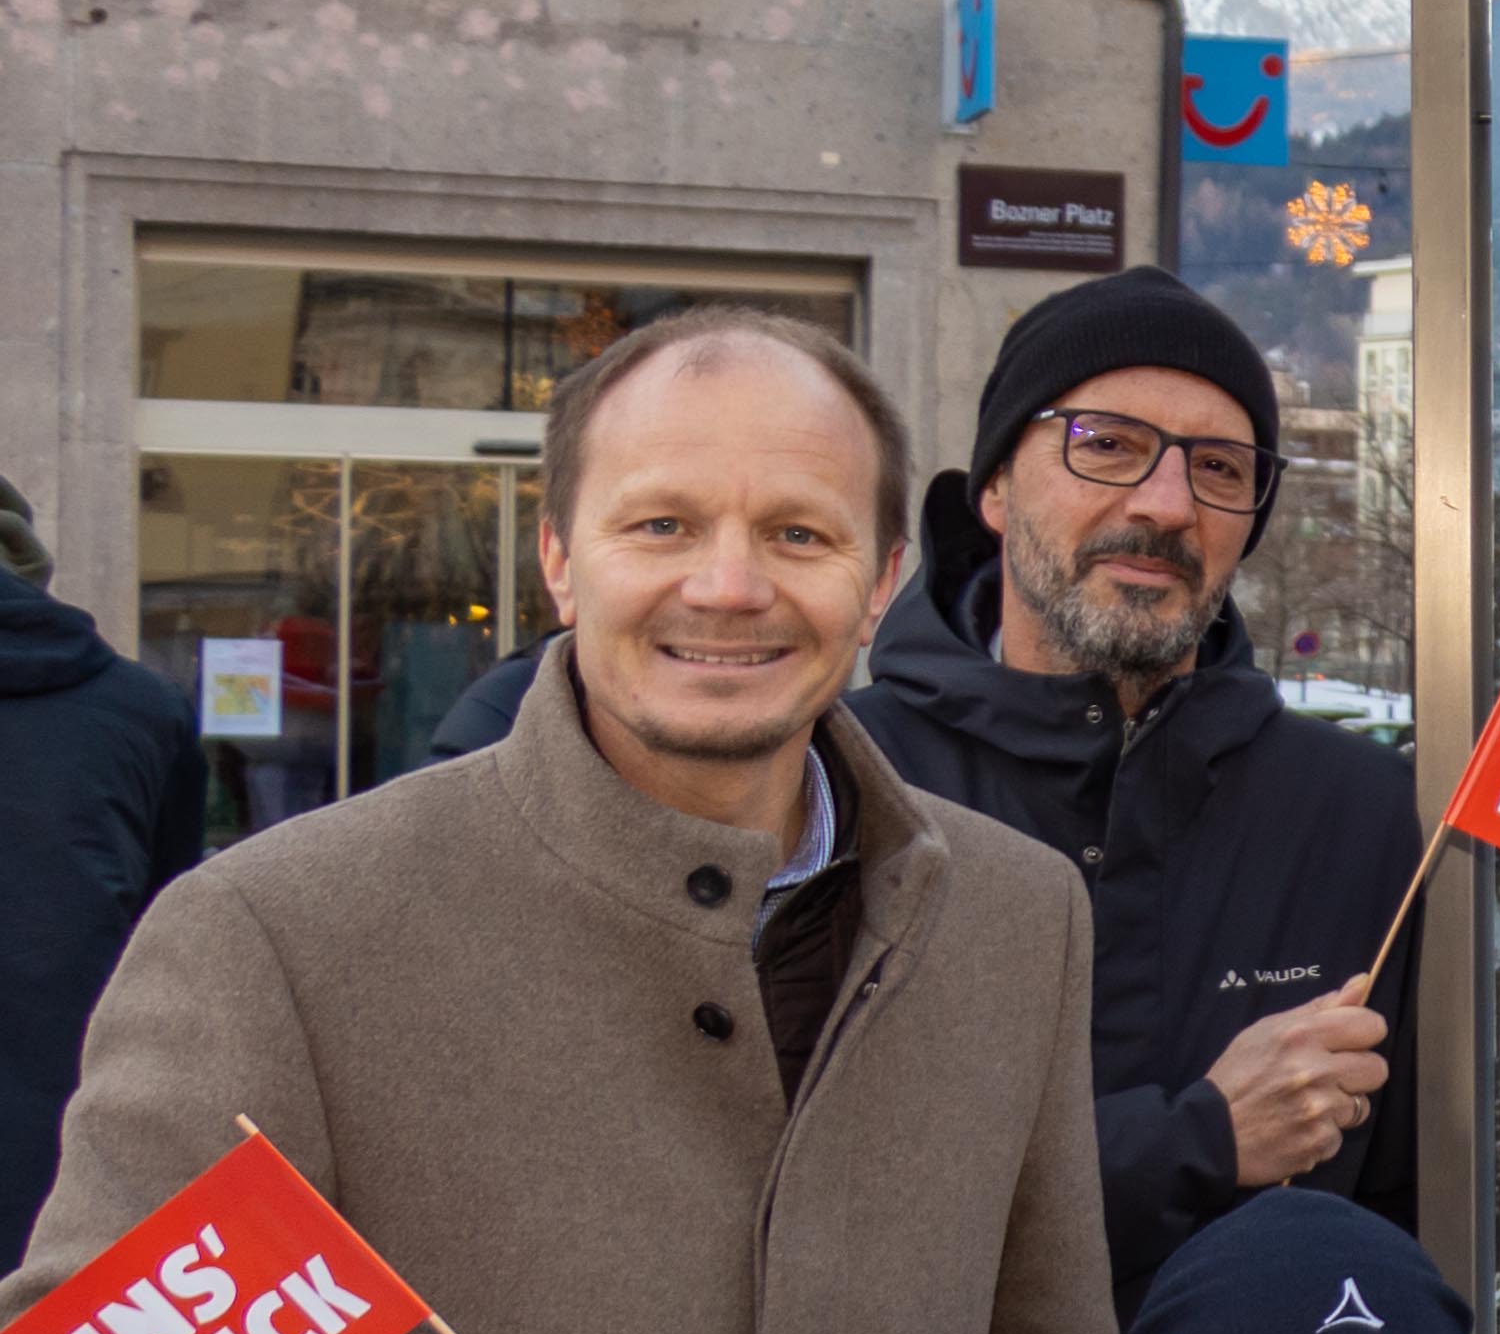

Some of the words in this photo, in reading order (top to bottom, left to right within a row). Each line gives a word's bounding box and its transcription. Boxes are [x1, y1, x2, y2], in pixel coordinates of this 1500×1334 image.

[990, 198, 1061, 224] Bozner
[1064, 202, 1115, 227] Platz
[1254, 964, 1321, 982] VAUDE
